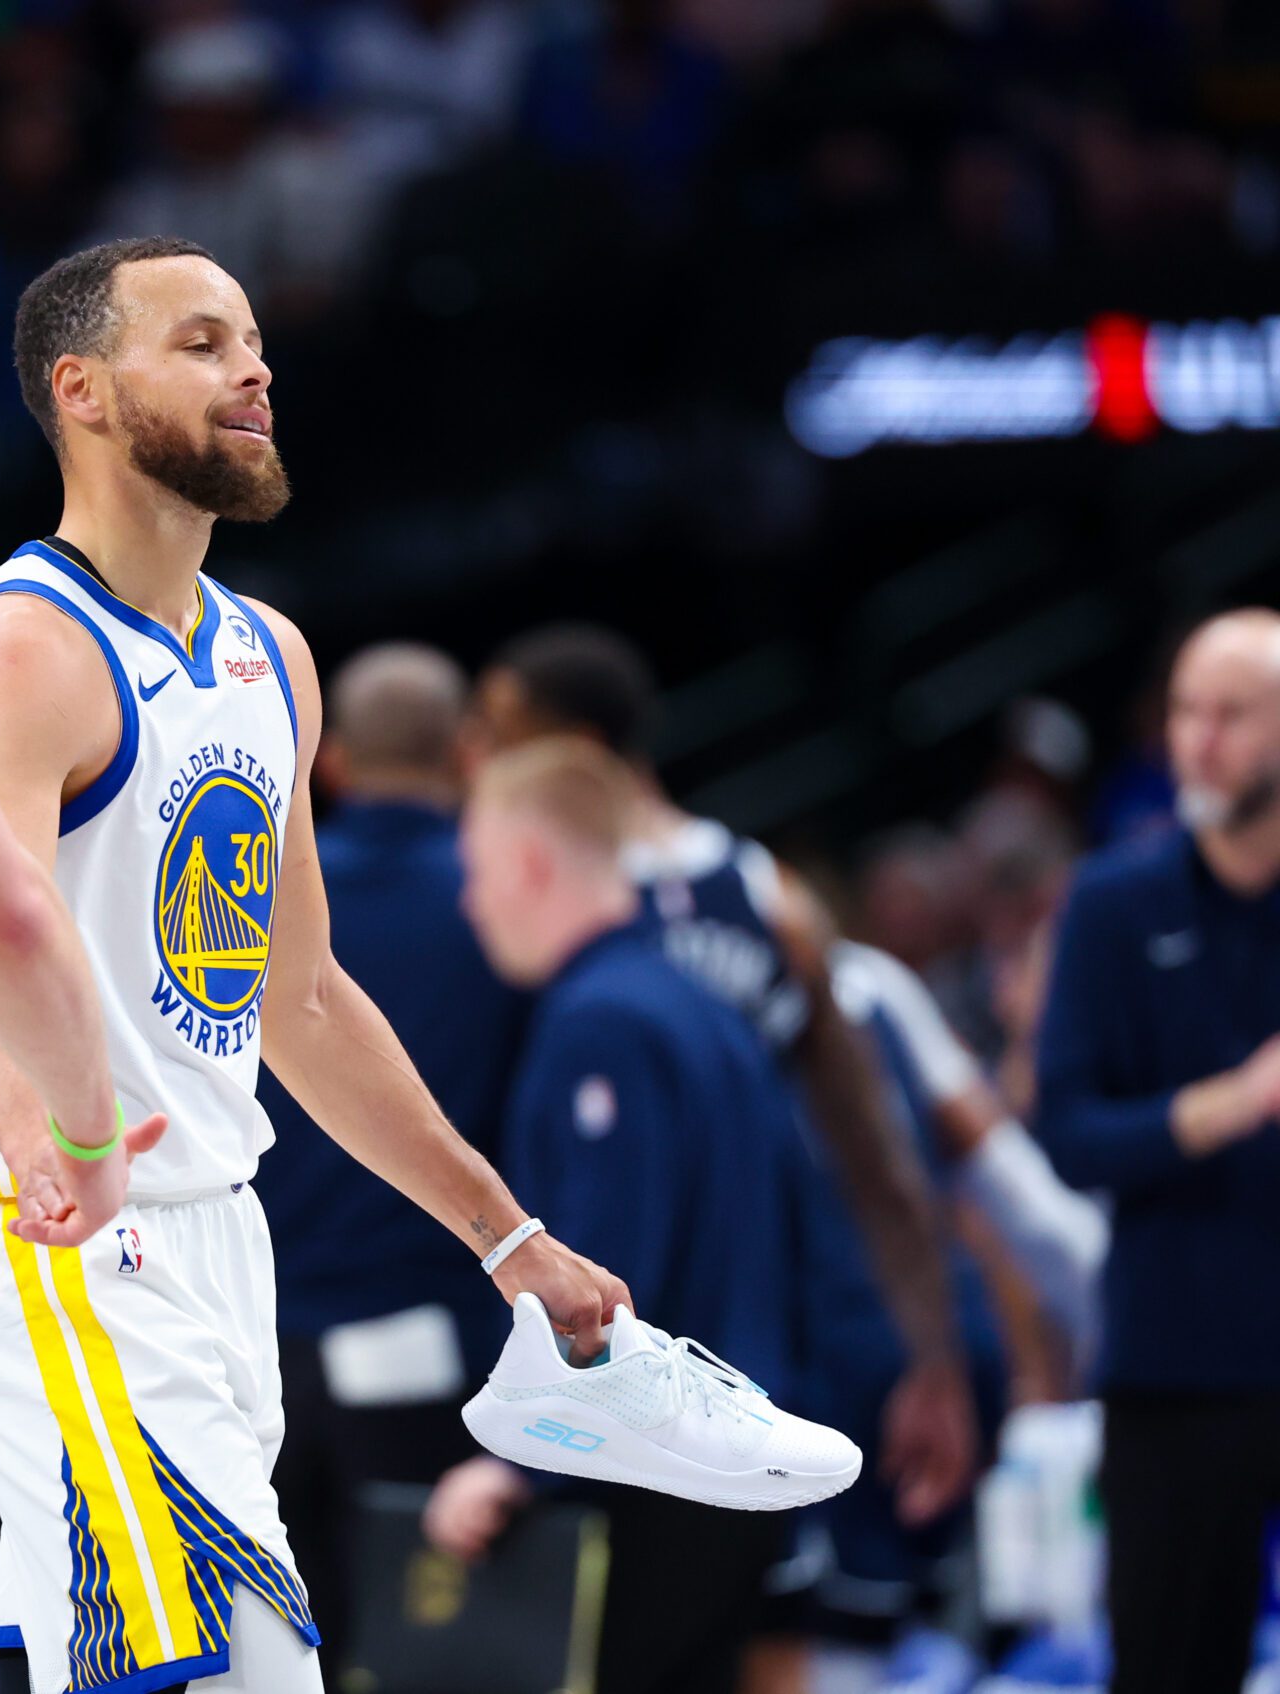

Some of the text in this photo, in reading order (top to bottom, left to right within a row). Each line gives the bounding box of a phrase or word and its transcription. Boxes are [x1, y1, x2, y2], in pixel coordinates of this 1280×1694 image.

[224, 656, 273, 678] Rakuten
[159, 743, 282, 823] GOLDEN STATE
[231, 832, 270, 898] 30
[523, 1418, 607, 1453] 30
